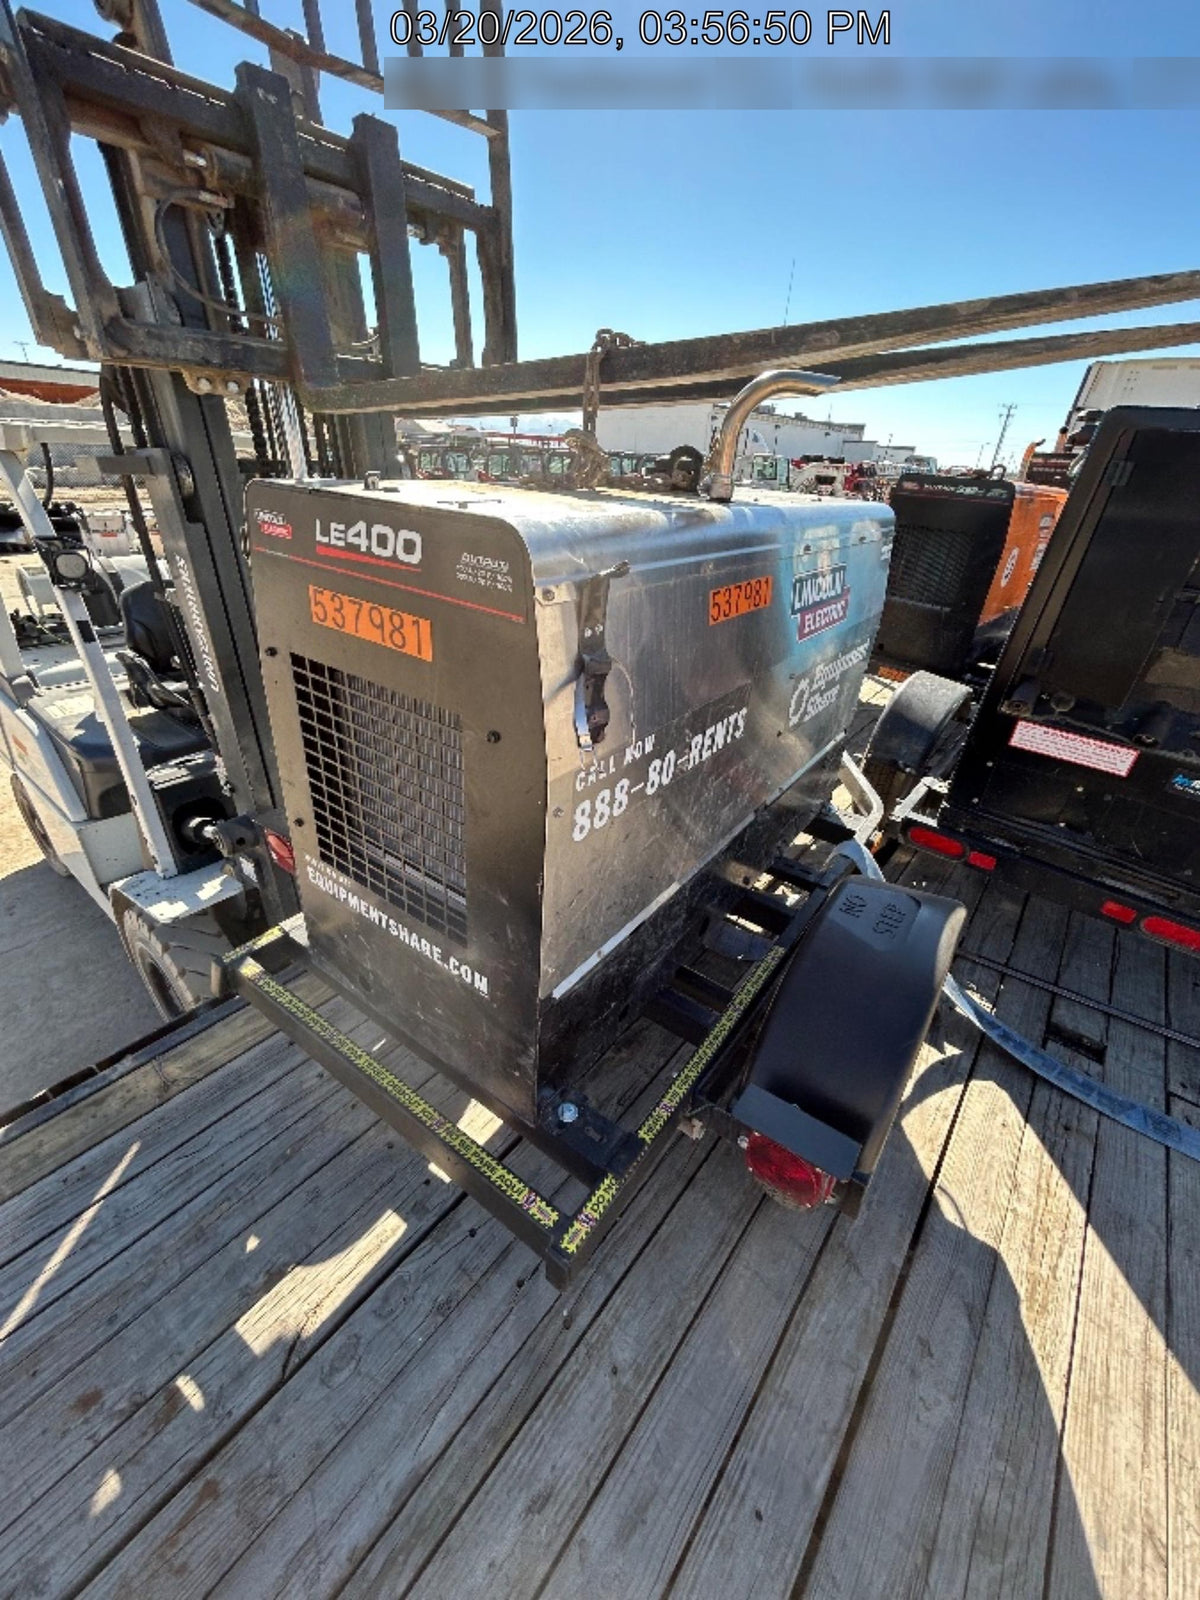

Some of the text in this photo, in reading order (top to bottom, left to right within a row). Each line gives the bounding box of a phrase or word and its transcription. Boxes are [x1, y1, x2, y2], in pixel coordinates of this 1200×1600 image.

[315, 518, 422, 565] LE400
[313, 588, 422, 656] 537981
[710, 577, 769, 622] 537981
[571, 706, 748, 842] 888-80-RENTS
[575, 733, 656, 792] CALL NOW
[306, 865, 489, 995] EQUIPMENTSHARE.COM
